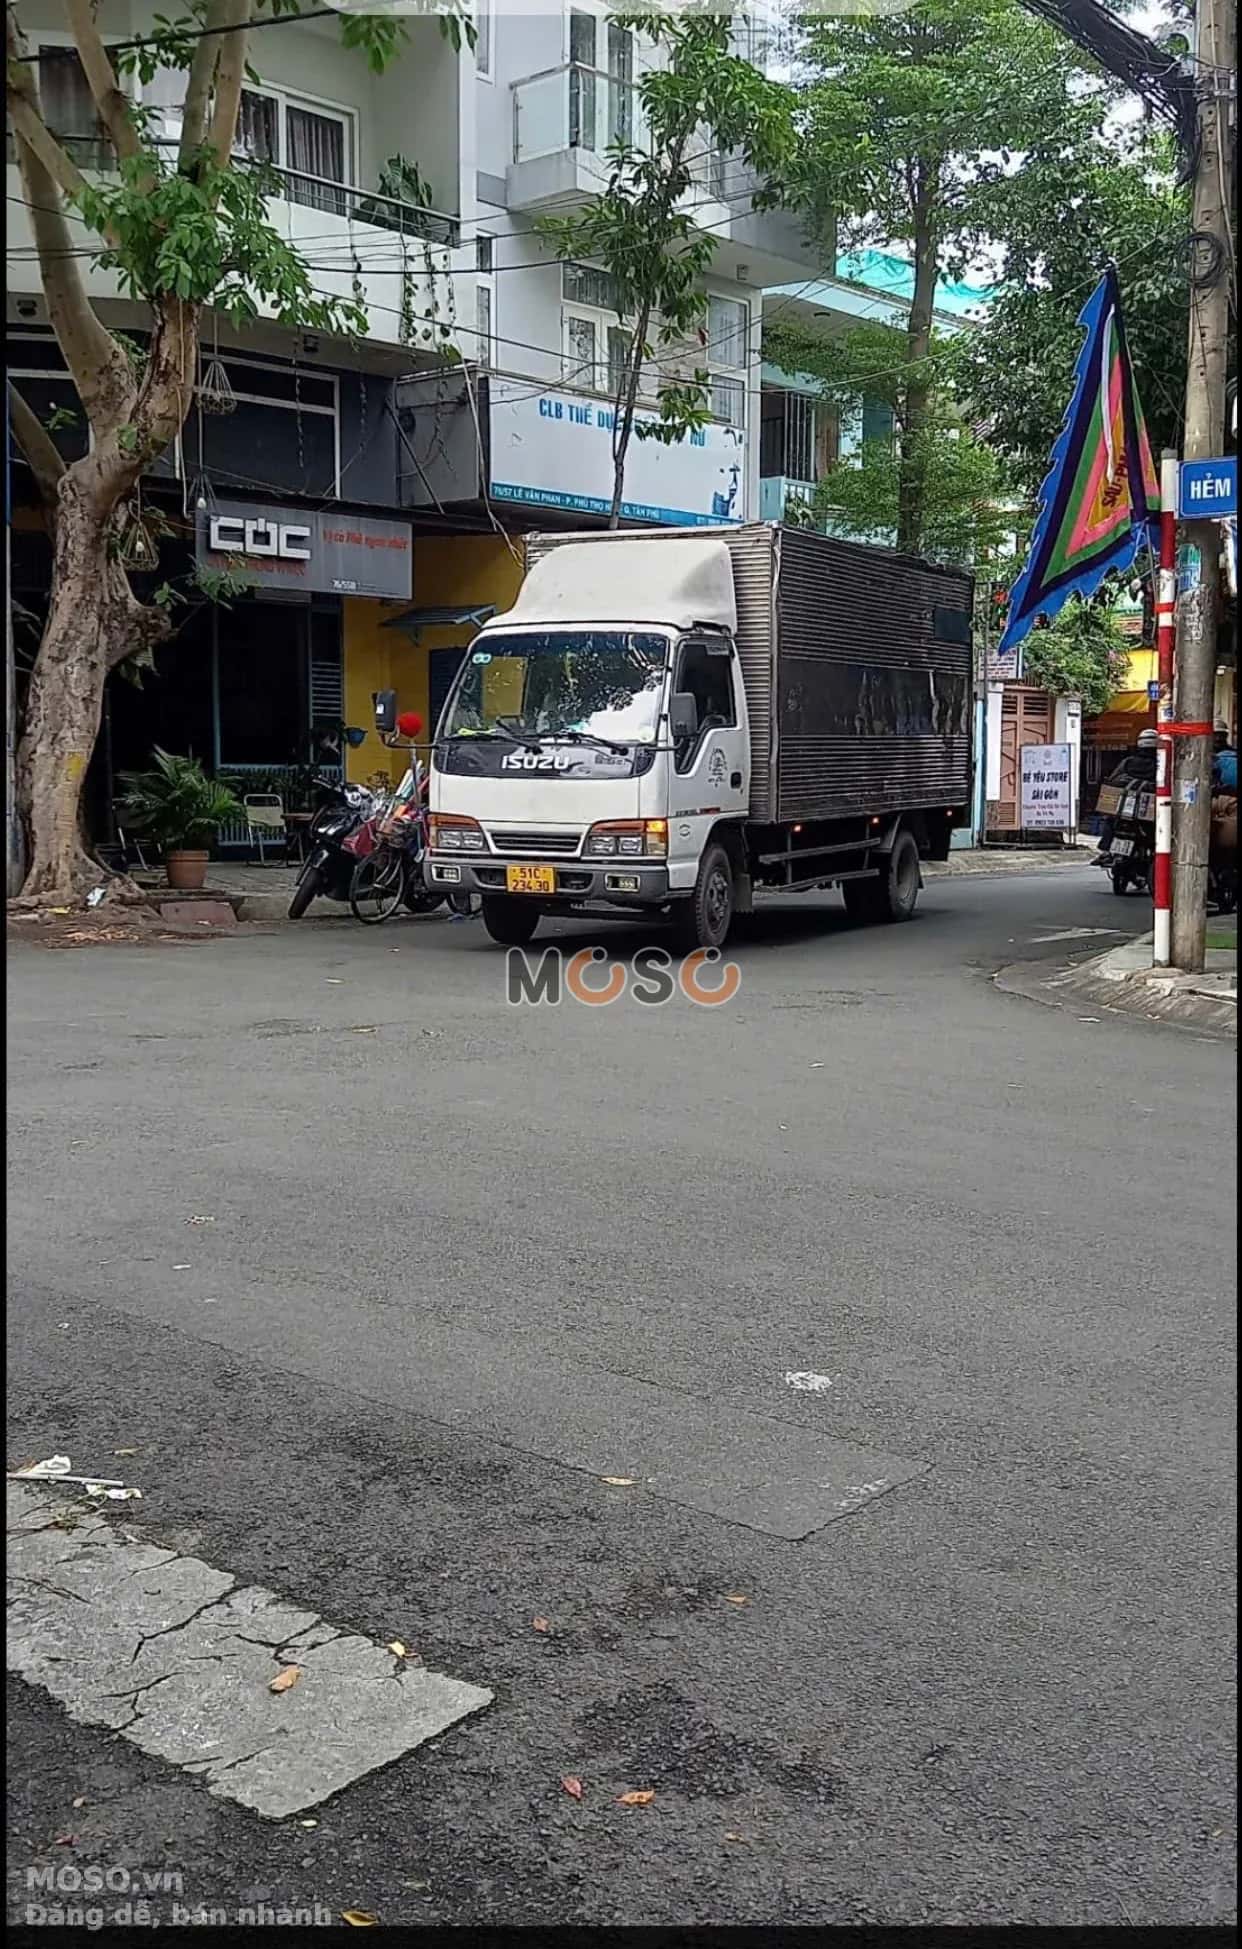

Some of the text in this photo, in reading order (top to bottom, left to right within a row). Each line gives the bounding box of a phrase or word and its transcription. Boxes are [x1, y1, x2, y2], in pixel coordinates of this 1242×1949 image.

[539, 398, 563, 419] CLB
[568, 402, 592, 426] THỂ
[1190, 472, 1231, 499] HẺM
[502, 755, 570, 770] ISUZU
[1046, 771, 1068, 783] STORE
[519, 867, 541, 879] 51C
[512, 878, 550, 892] 234.30
